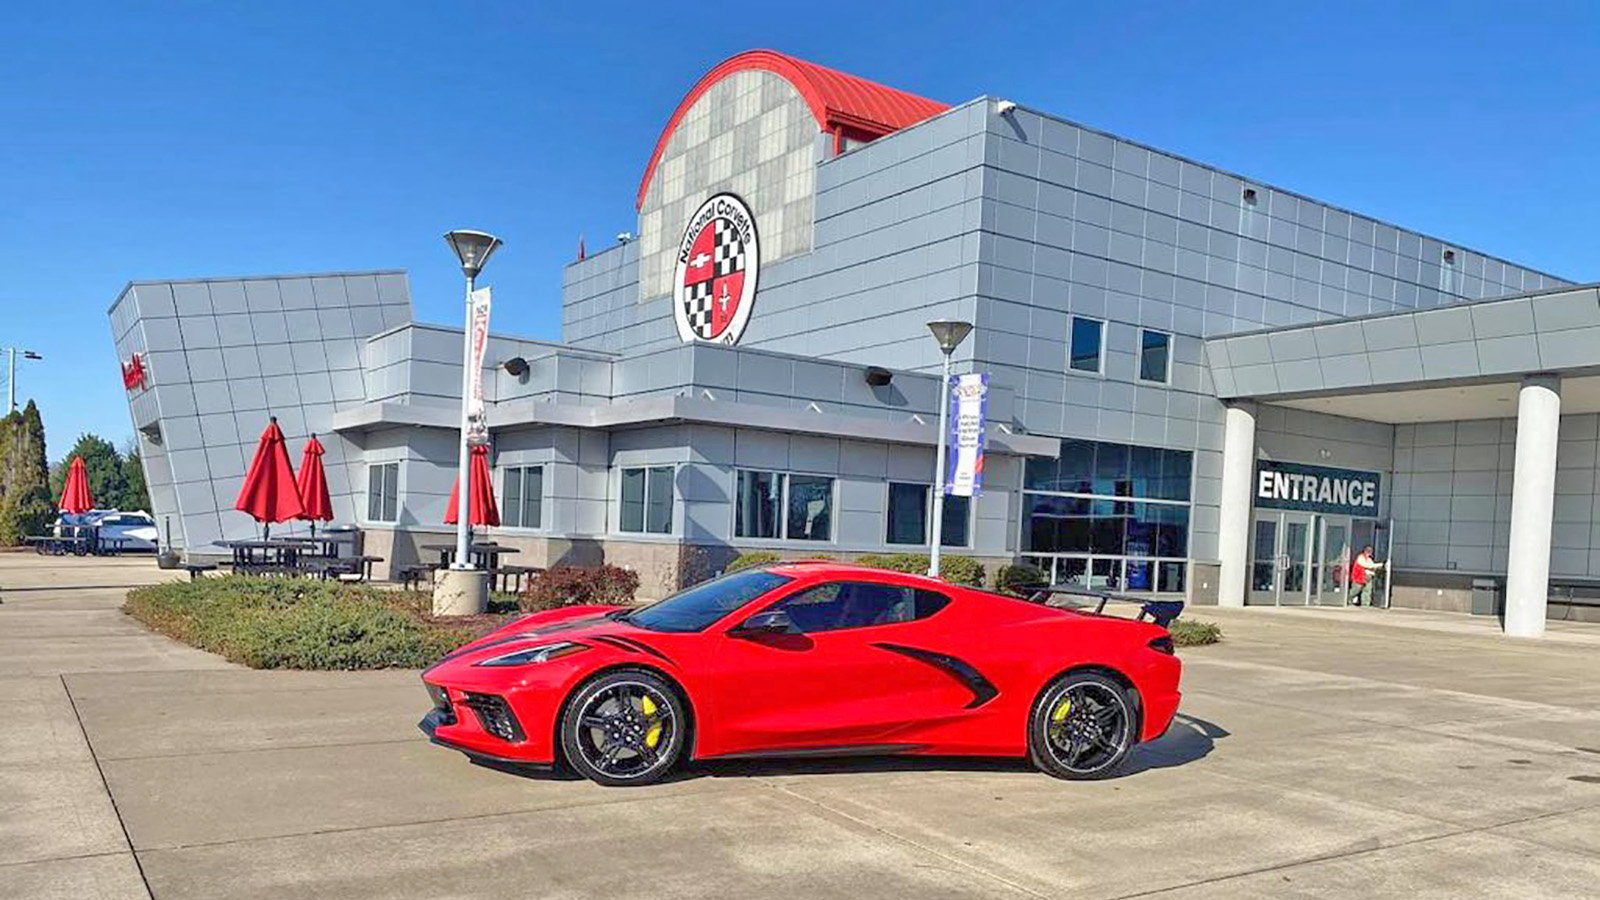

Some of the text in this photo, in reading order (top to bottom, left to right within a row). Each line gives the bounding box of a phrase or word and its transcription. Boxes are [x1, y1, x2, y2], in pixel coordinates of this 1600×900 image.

[680, 199, 751, 263] National Corvette
[1258, 470, 1376, 507] ENTRANCE
